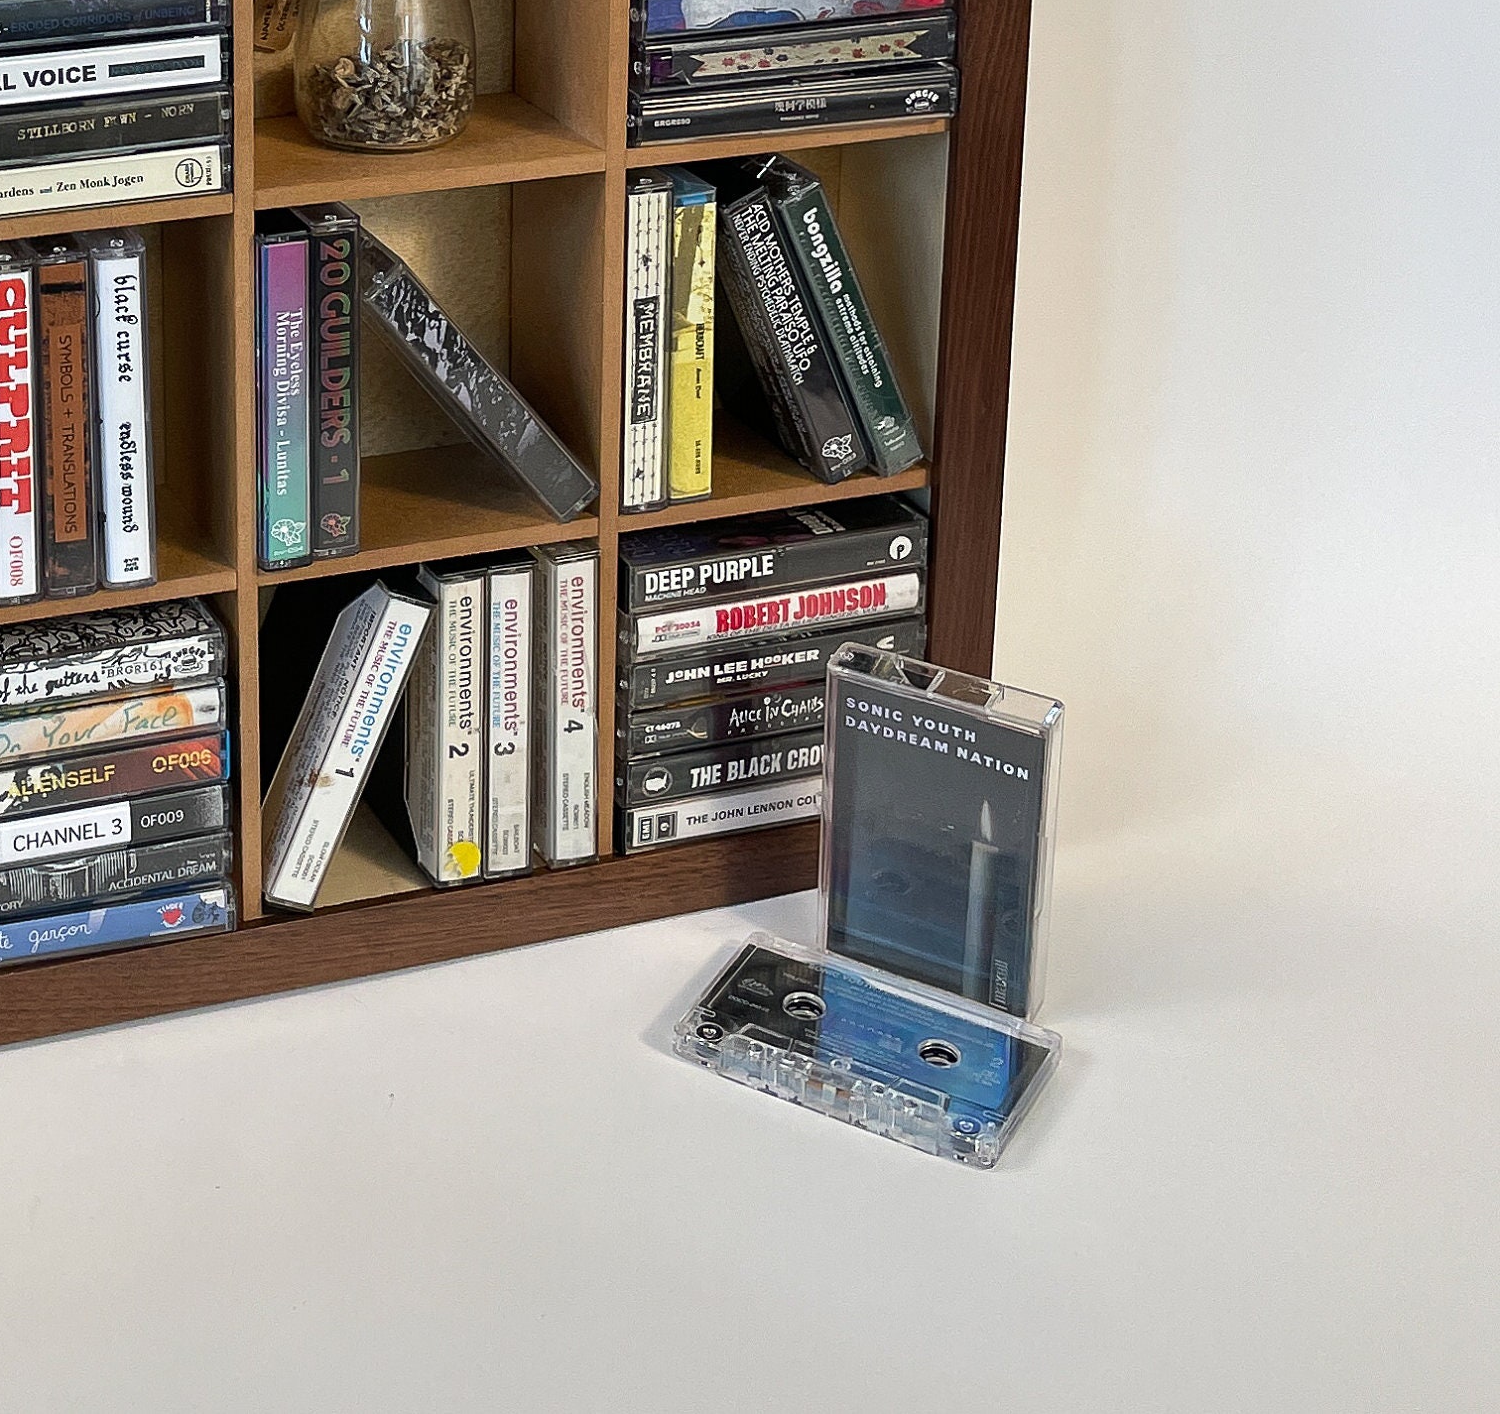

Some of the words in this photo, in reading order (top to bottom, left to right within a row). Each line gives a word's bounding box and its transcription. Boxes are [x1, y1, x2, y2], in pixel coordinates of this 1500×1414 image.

[23, 65, 97, 88] VOICE
[56, 182, 77, 192] Zen
[80, 178, 110, 189] Monk
[112, 174, 144, 187] Jogen
[320, 241, 350, 285] 20
[803, 207, 843, 295] bongzilla
[58, 335, 72, 403] SYMBOLS
[320, 292, 350, 448] GUILDERS
[60, 423, 77, 534] TRANSLATIONS
[8, 535, 24, 585] OF008
[645, 569, 693, 594] DEEP
[699, 555, 774, 586] PURPLE
[716, 600, 790, 634] ROBERT
[794, 583, 886, 619] JOHNSON
[713, 661, 747, 675] LEE
[563, 720, 583, 733] 4
[846, 697, 903, 722] SONIC
[912, 712, 976, 742] YOUTH
[449, 742, 469, 759] 2
[494, 742, 514, 756] 3
[845, 716, 949, 753] DAYDREAM
[956, 746, 1029, 780] NATION
[690, 768, 721, 787] THE
[727, 752, 781, 781] BLACK
[140, 810, 183, 827] OF009
[686, 815, 708, 826] THE
[712, 809, 744, 820] JOHN
[747, 801, 793, 814] LENNON
[13, 822, 105, 852] CHANNEL
[111, 817, 122, 834] 3
